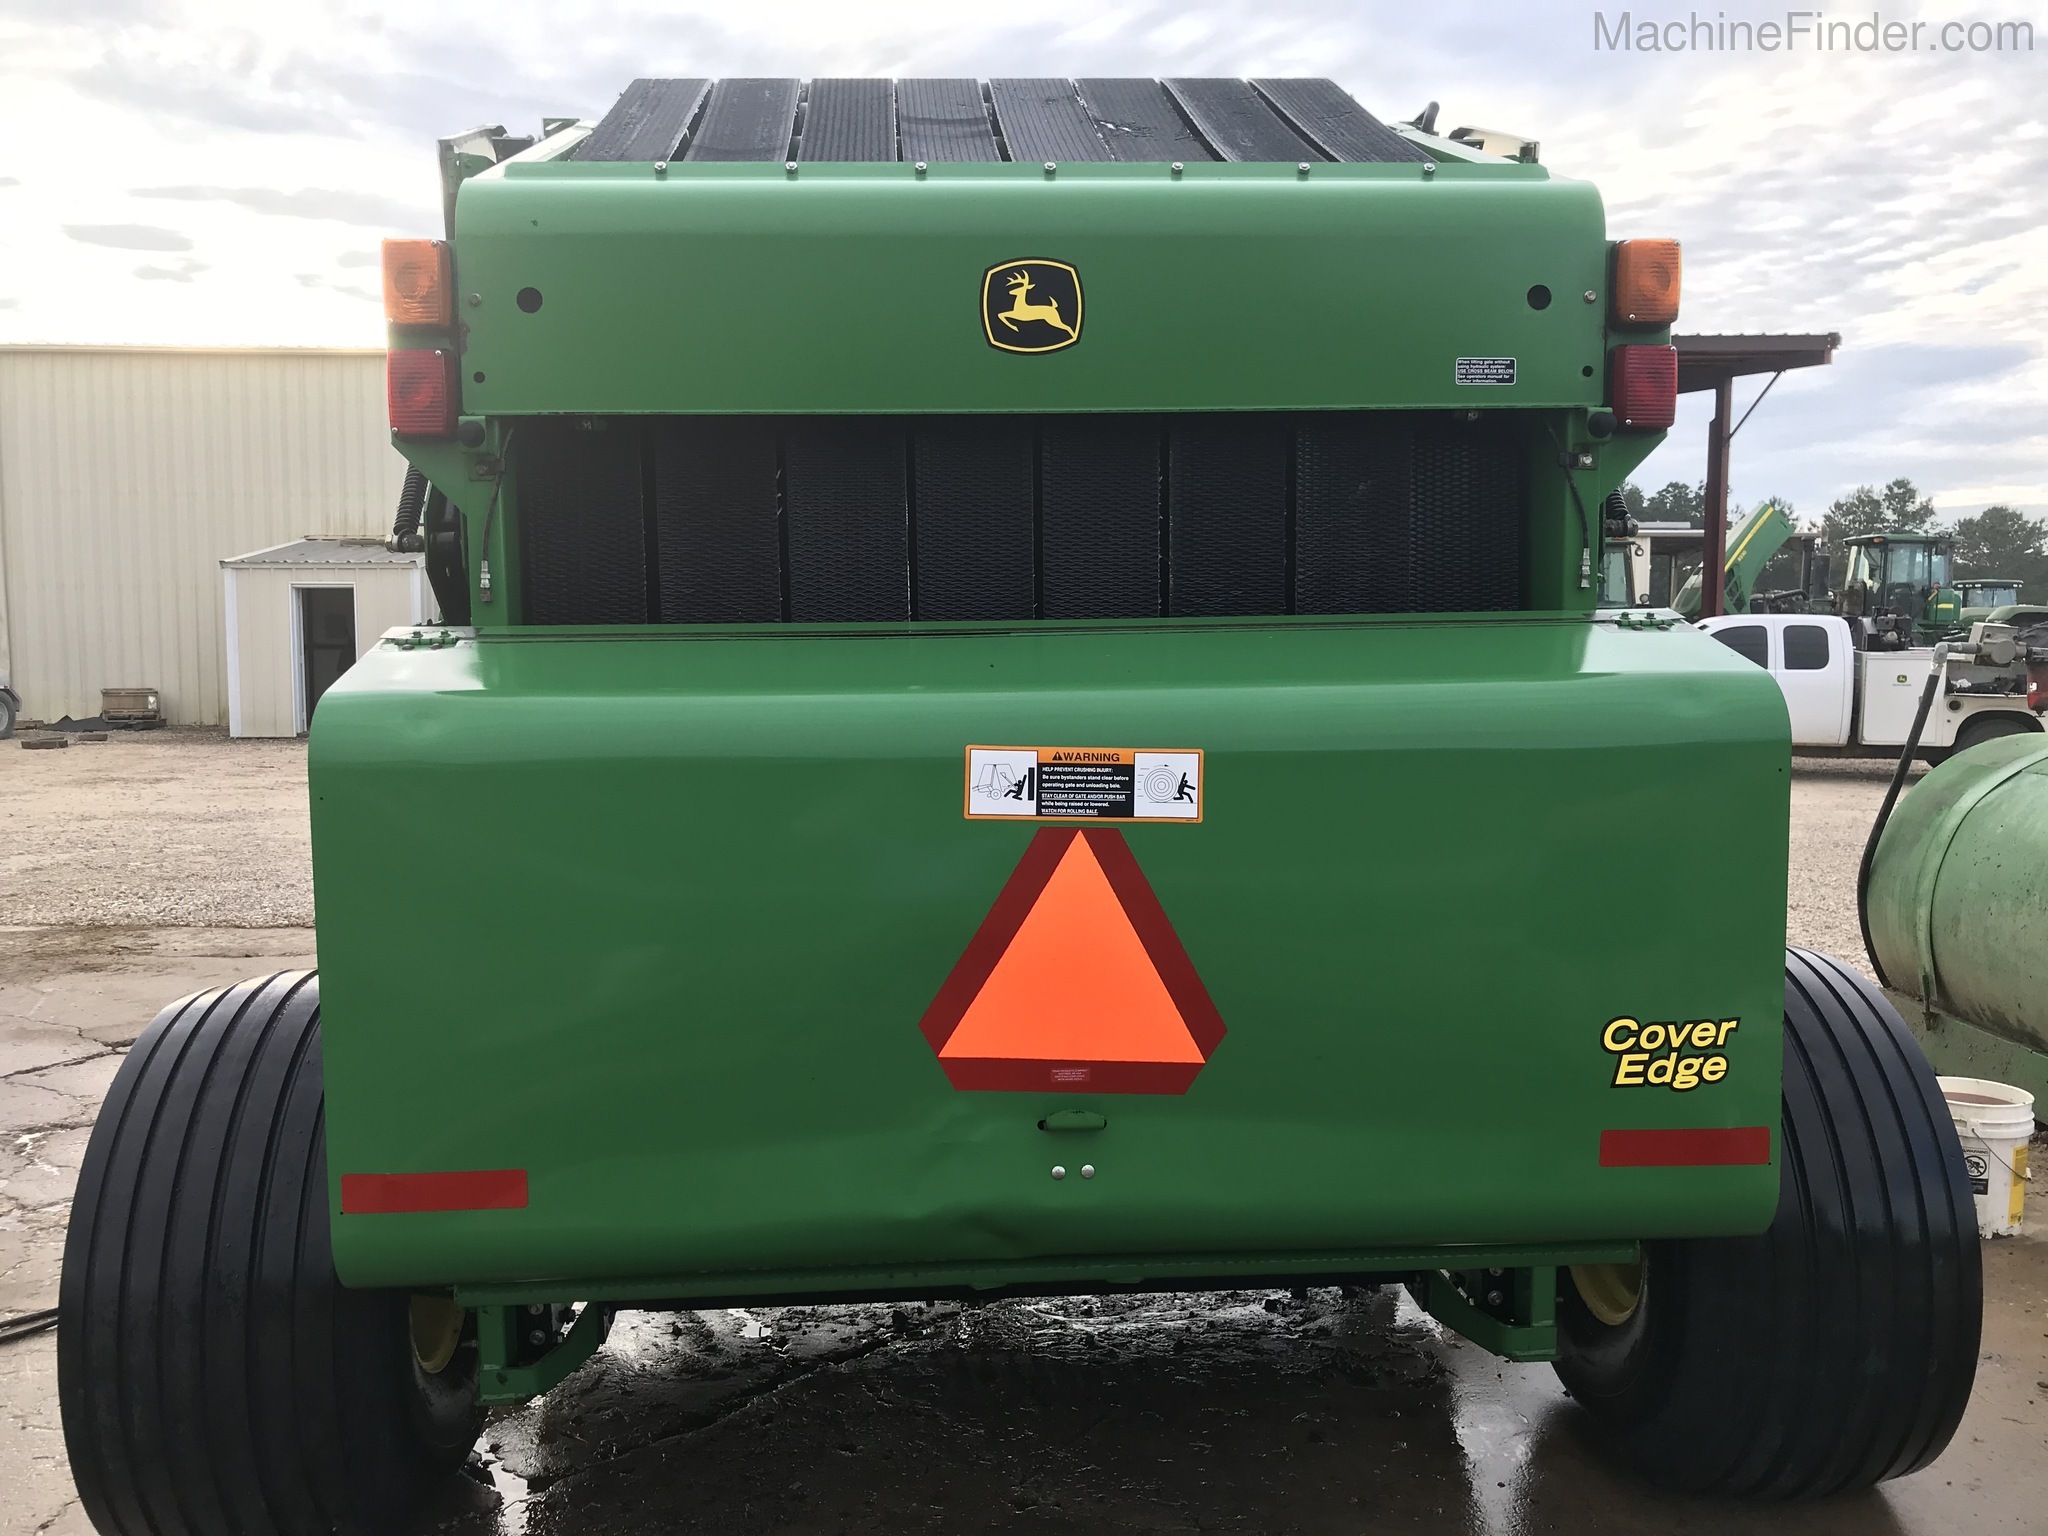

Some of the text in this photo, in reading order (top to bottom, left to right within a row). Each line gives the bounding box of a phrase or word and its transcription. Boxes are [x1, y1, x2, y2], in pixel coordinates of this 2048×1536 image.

[1063, 752, 1120, 762] WARNING
[1602, 1017, 1739, 1052] Cover
[1613, 1051, 1729, 1091] Edge
